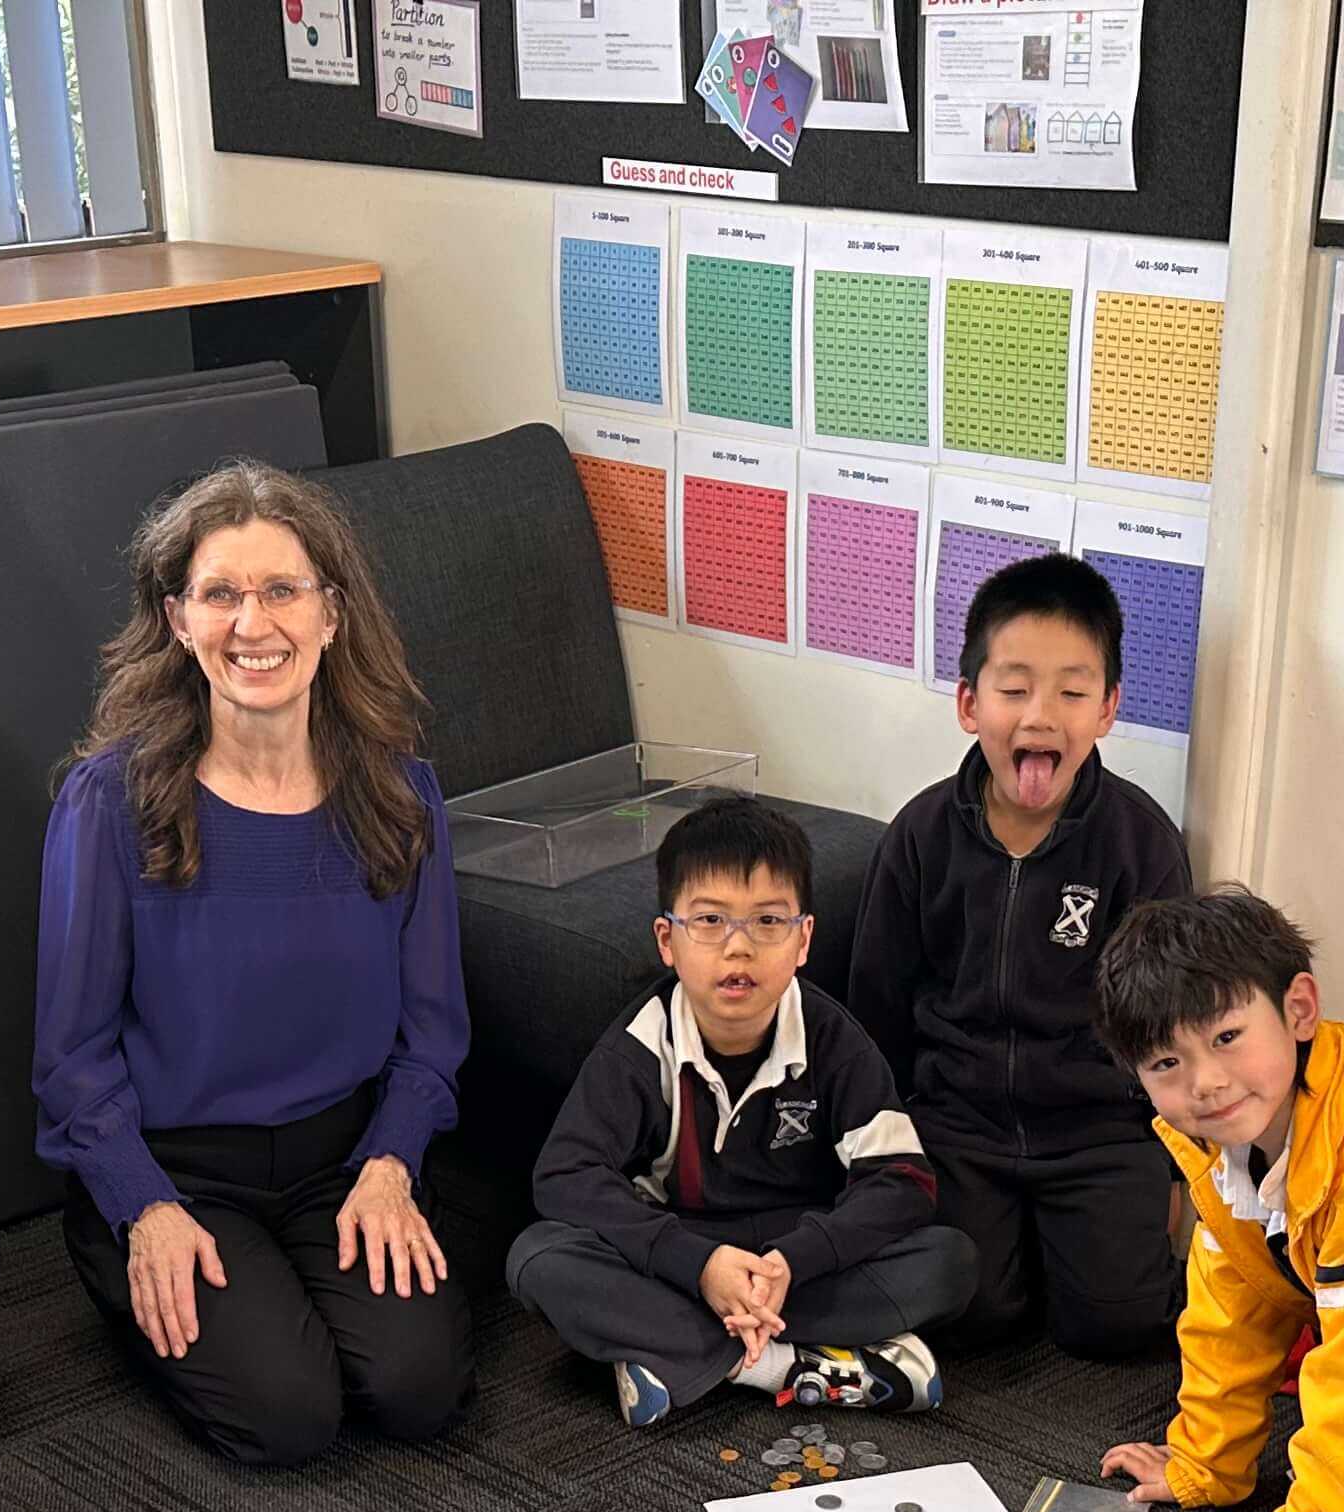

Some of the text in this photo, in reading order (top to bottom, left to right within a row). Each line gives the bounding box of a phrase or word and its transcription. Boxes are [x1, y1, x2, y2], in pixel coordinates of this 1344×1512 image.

[391, 0, 444, 26] Partition
[381, 29, 390, 40] to
[393, 32, 412, 43] break
[428, 37, 455, 50] number
[399, 50, 424, 61] smaller
[610, 161, 735, 190] Guess and check
[610, 213, 630, 223] Square
[745, 230, 766, 241] Square
[847, 240, 900, 252] 201-300 Square
[982, 249, 1041, 263] 301-400 Square
[1135, 260, 1198, 275] 401-500 Square
[621, 434, 640, 445] Square
[738, 454, 759, 465] Square
[866, 472, 889, 484] Square
[974, 495, 1030, 513] 801-900 Square
[1118, 522, 1182, 539] 901-1000 Square
